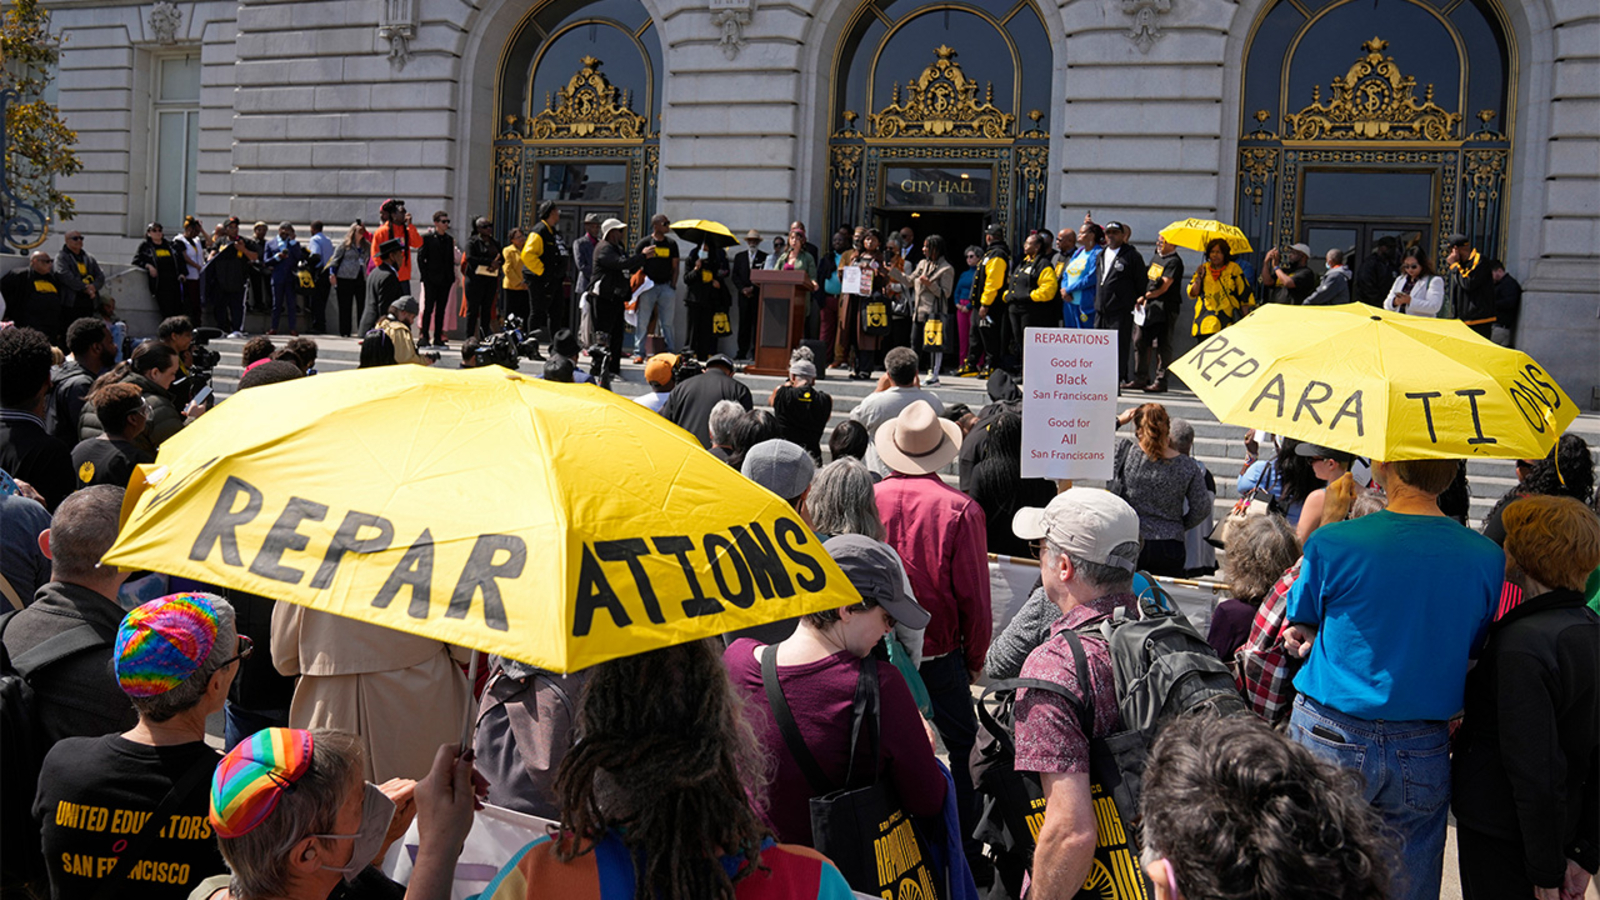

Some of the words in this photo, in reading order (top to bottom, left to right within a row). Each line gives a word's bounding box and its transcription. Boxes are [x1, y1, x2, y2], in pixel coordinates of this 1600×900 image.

[1034, 332, 1110, 346] REPARATIONS
[1050, 357, 1077, 368] Good
[1079, 358, 1093, 368] for
[1055, 373, 1088, 386] Black
[1033, 389, 1051, 400] San
[1053, 390, 1109, 401] Franciscans
[1047, 417, 1075, 428] Good
[1077, 418, 1091, 428] for
[1061, 433, 1077, 445] All
[1031, 449, 1049, 459] San
[1051, 449, 1105, 461] Franciscans
[55, 800, 109, 832] UNITED
[110, 809, 212, 840] EDUTORS
[61, 852, 93, 878] SAN
